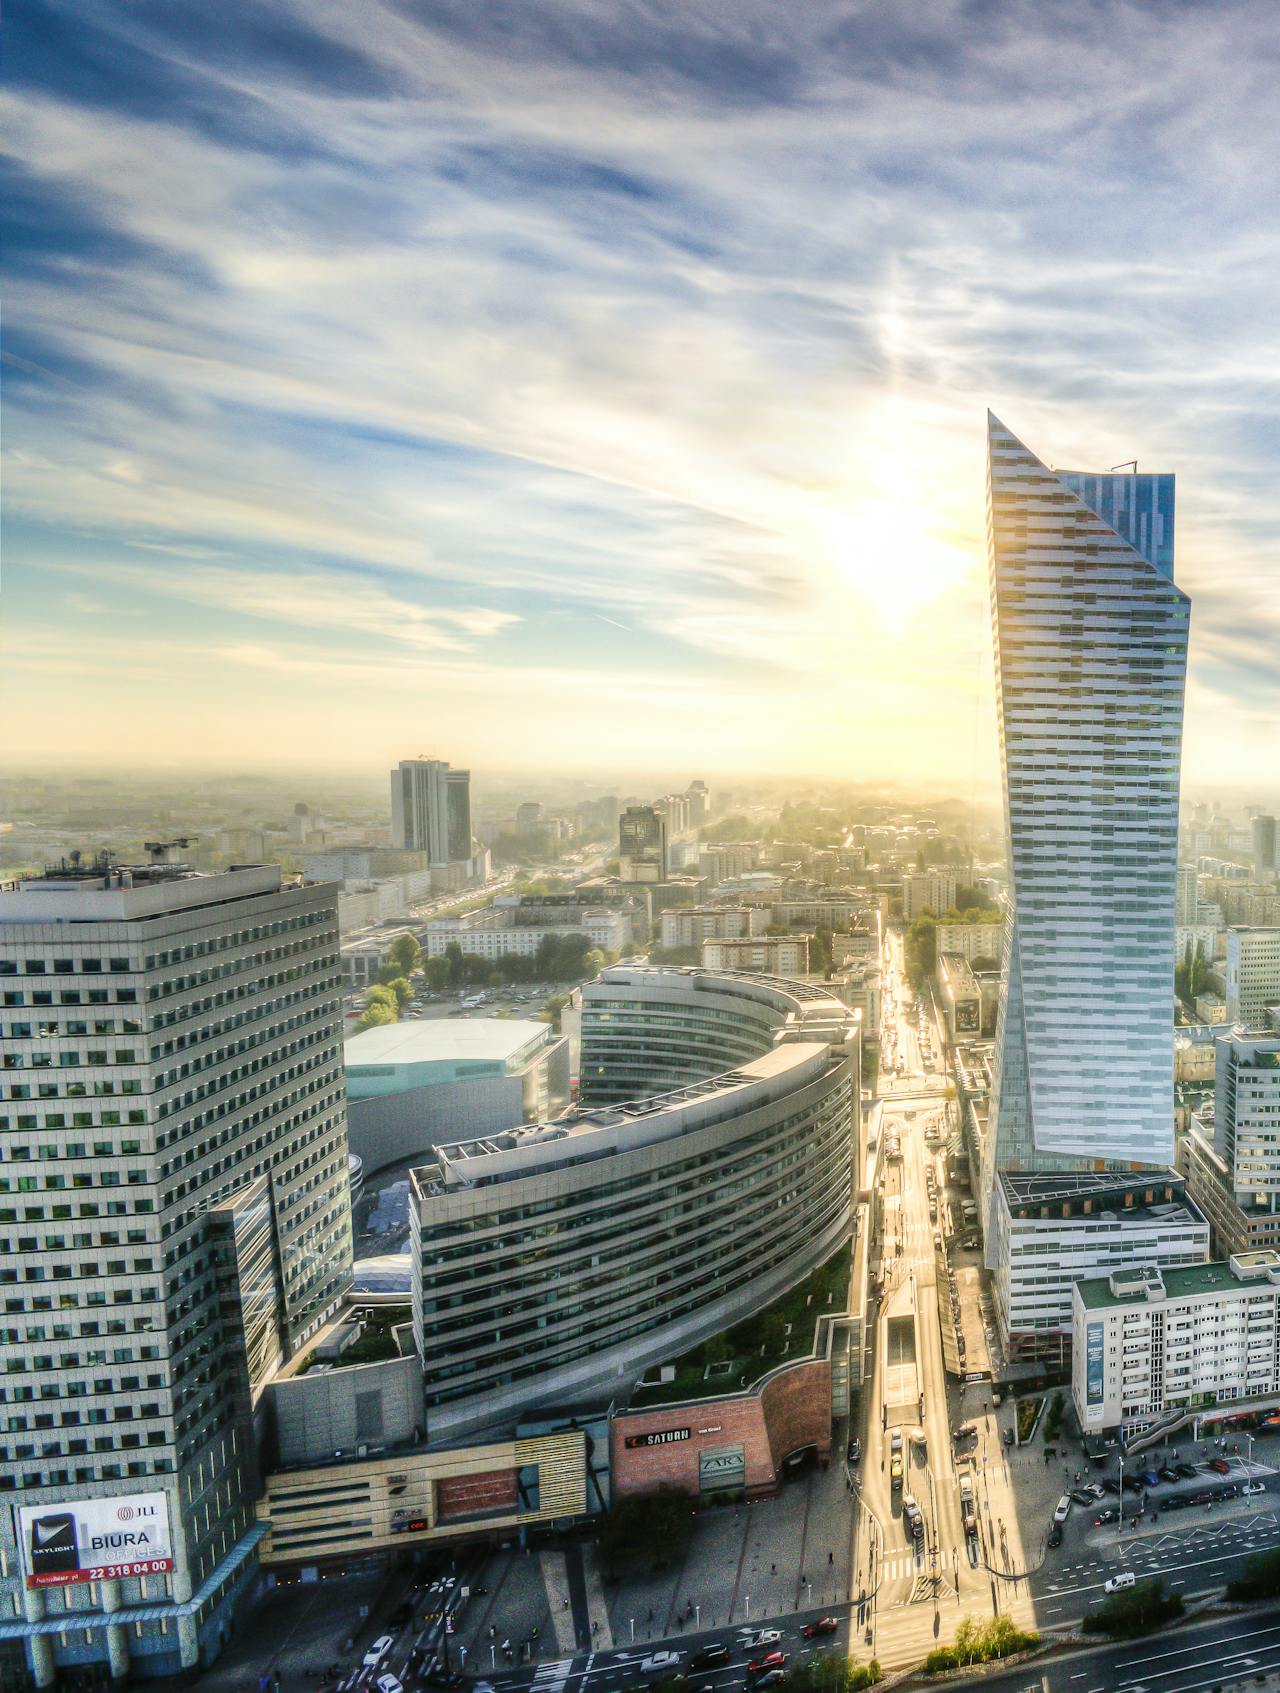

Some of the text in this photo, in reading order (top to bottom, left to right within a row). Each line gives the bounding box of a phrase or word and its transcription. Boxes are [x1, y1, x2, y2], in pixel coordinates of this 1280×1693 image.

[647, 1429, 689, 1445] SATURN
[703, 1456, 743, 1469] ZARA
[136, 1506, 158, 1517] JLL
[91, 1532, 150, 1549] BIURA
[33, 1544, 75, 1554] SKYLIGHT
[105, 1546, 166, 1561] OFFICES
[89, 1569, 105, 1579] 22
[108, 1564, 130, 1577] 318
[133, 1562, 149, 1574] 04
[151, 1560, 167, 1571] 00
